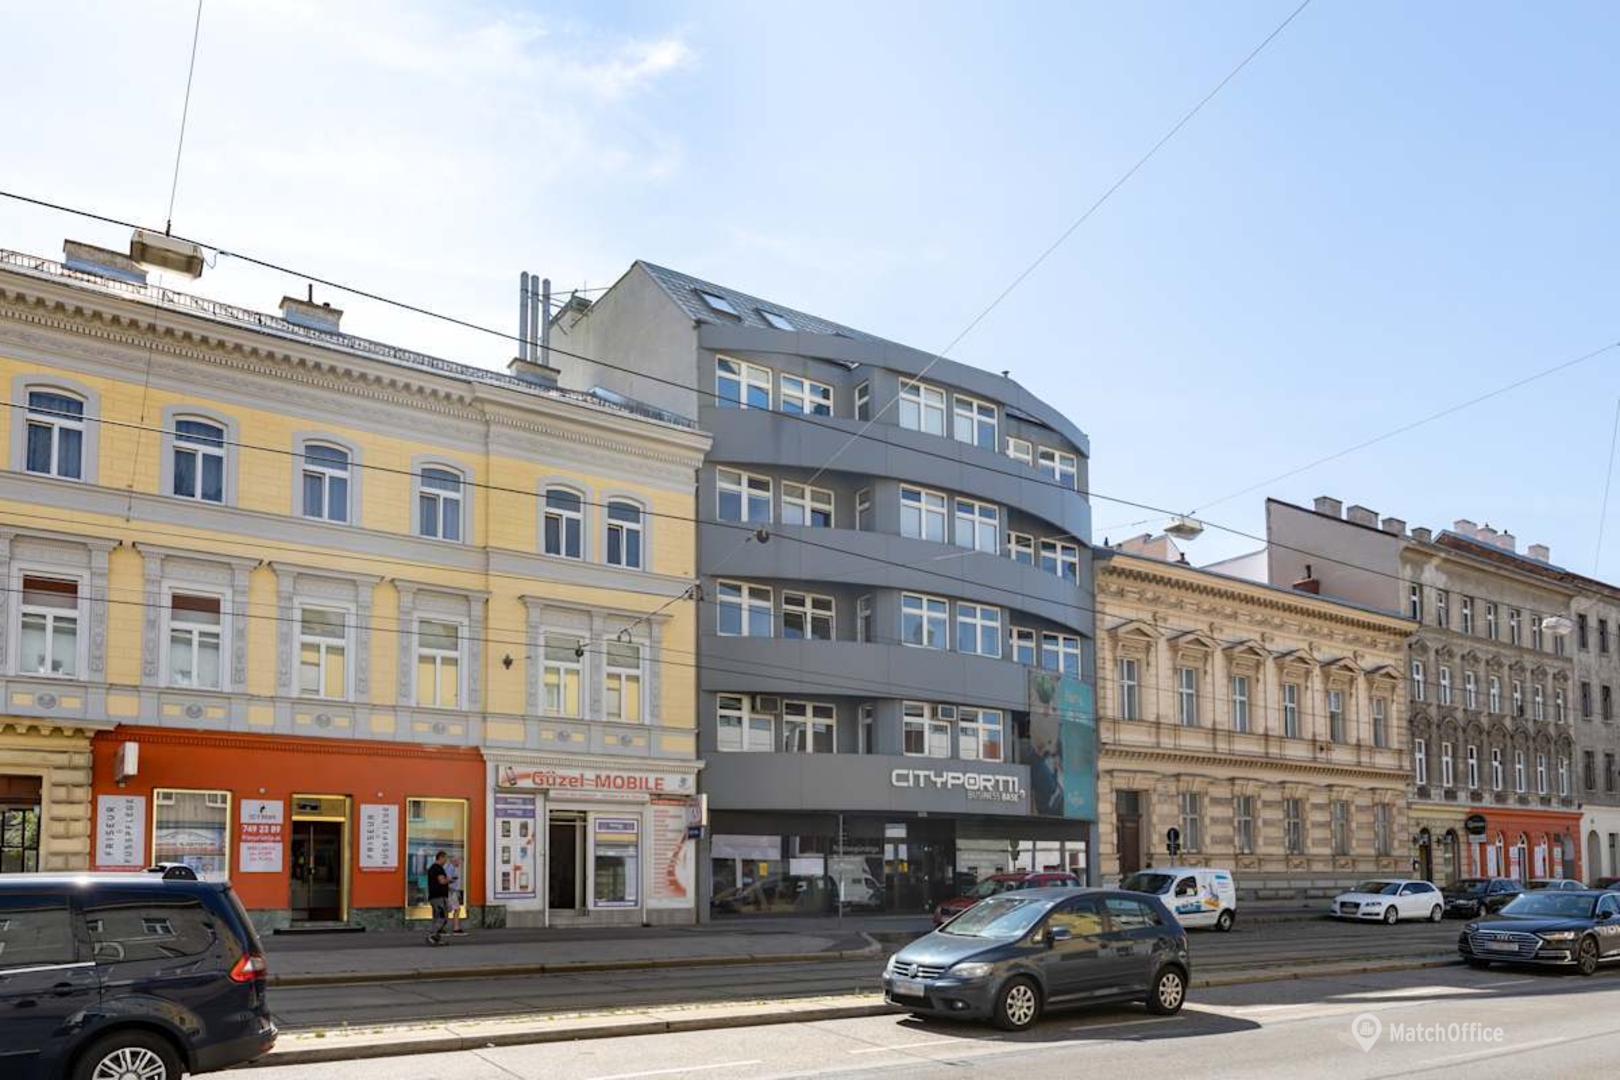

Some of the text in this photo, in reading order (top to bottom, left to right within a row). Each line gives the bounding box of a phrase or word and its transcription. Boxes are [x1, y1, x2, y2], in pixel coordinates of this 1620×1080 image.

[104, 806, 116, 856] FRISEUR
[123, 799, 134, 864] FUSSPFLEGE
[366, 814, 375, 859] FRISEUR
